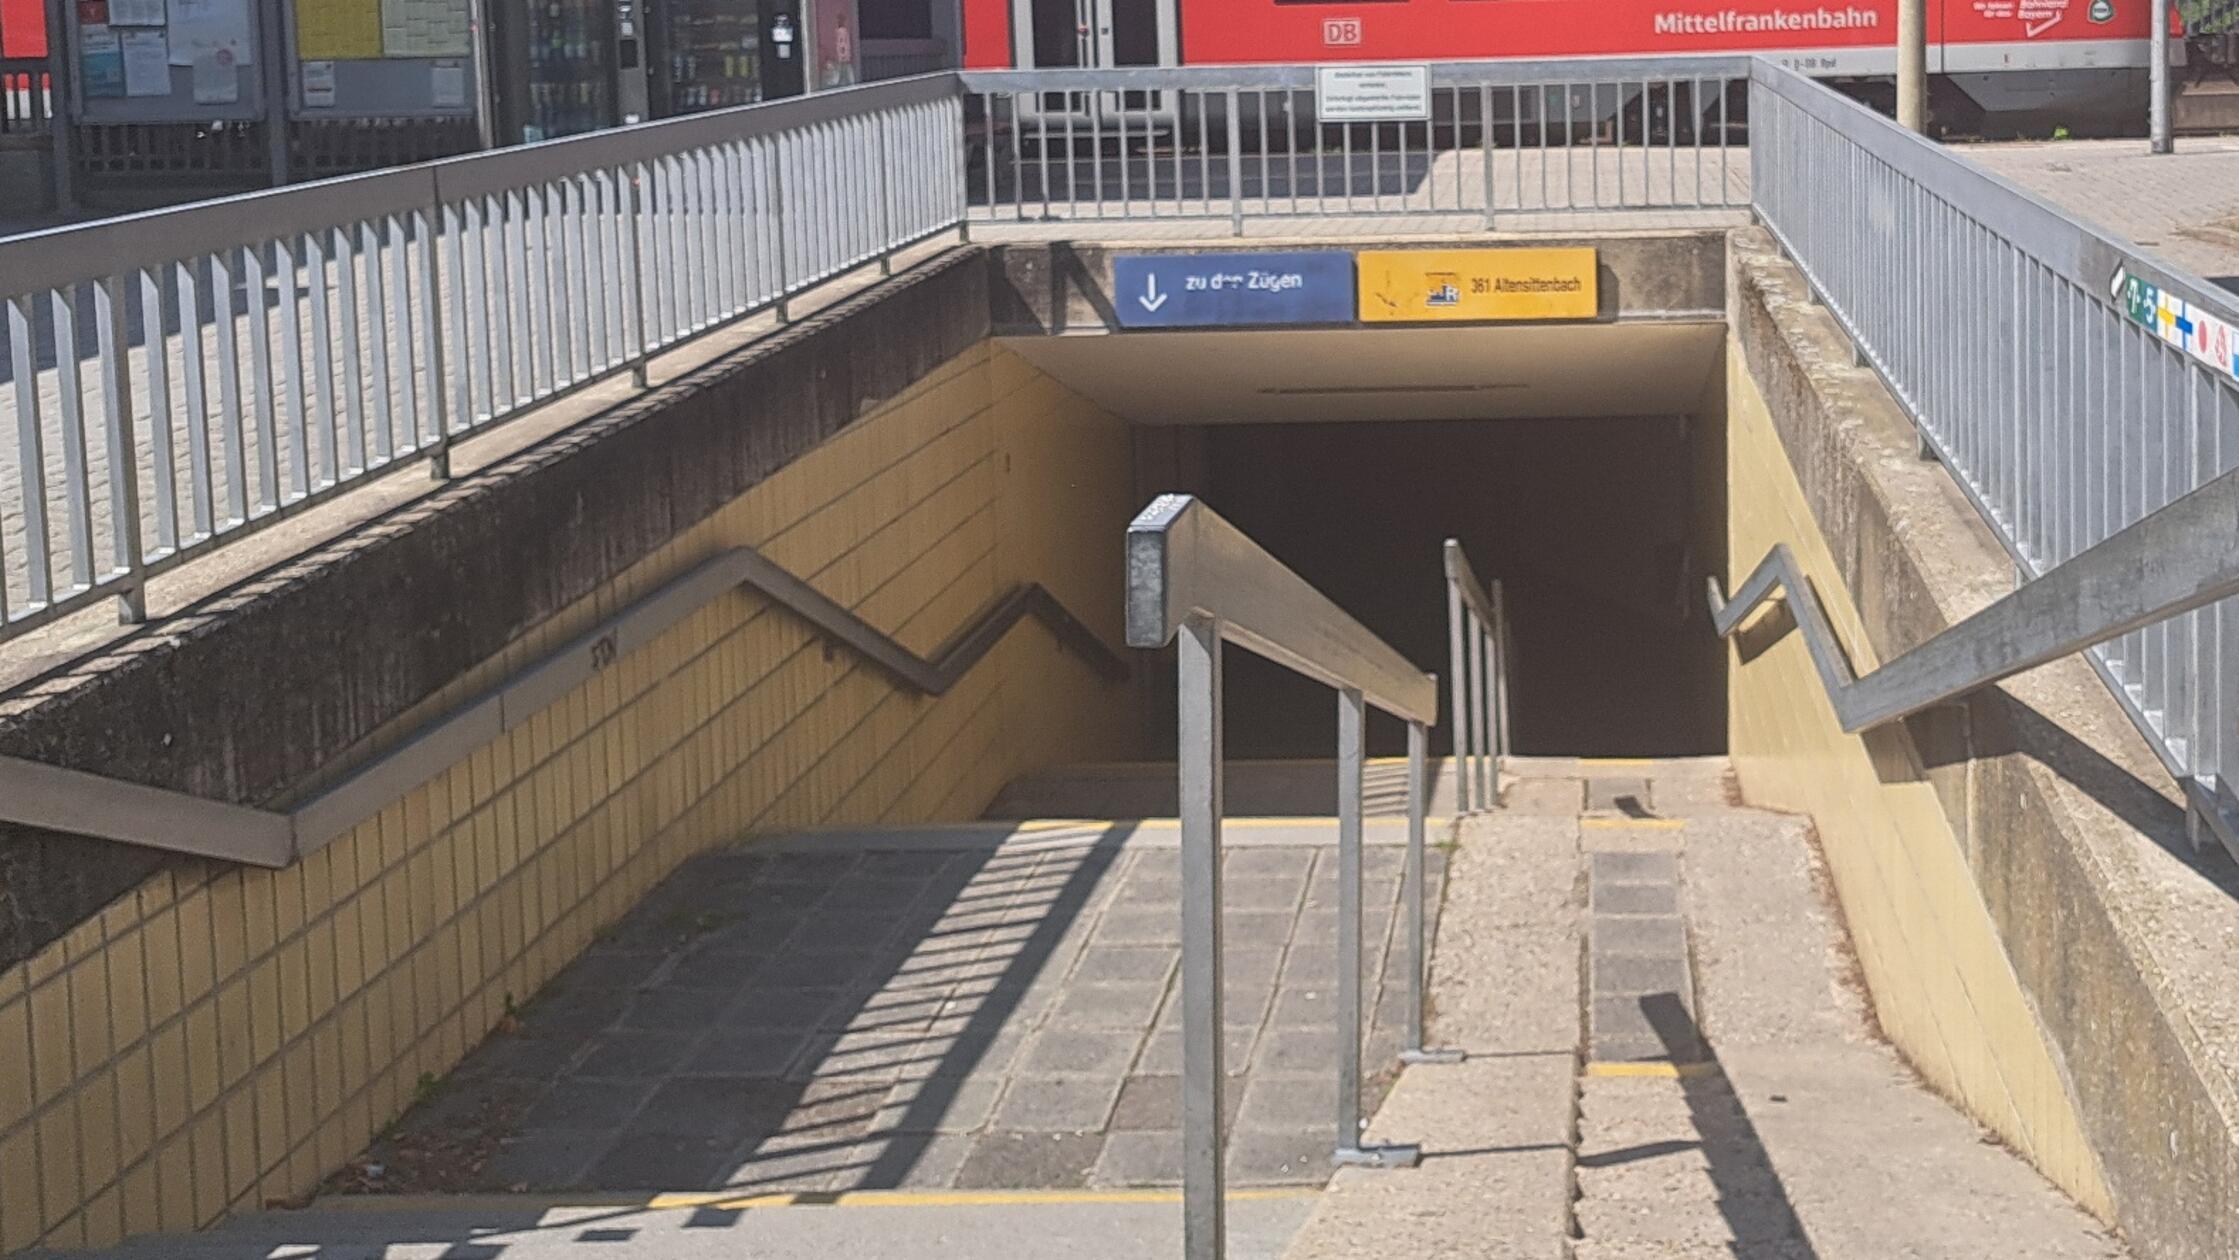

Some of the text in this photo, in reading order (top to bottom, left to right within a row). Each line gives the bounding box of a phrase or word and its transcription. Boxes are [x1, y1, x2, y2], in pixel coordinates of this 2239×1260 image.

[1654, 7, 1877, 33] Mittelfrankenbahn
[1327, 23, 1357, 42] DB
[1185, 275, 1207, 290] zu
[1248, 271, 1303, 293] Zügen
[1495, 277, 1582, 292] Altensittenbach
